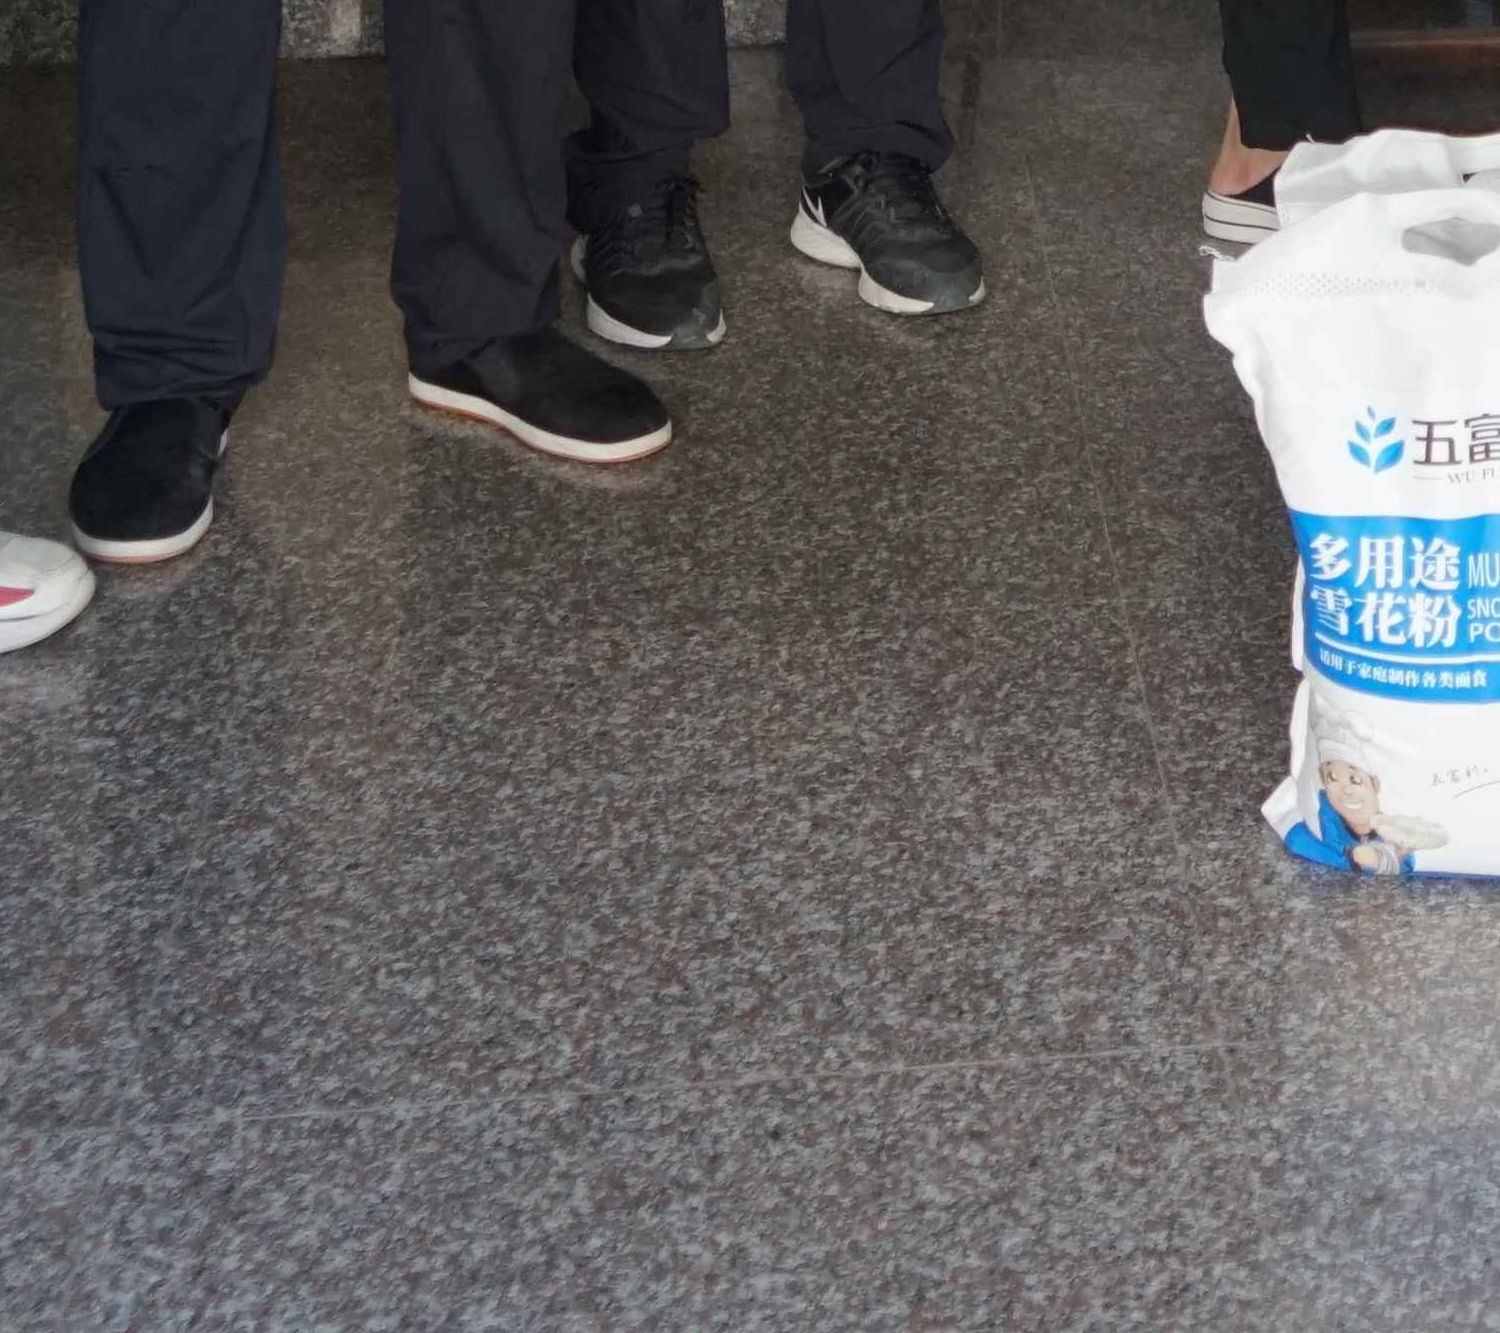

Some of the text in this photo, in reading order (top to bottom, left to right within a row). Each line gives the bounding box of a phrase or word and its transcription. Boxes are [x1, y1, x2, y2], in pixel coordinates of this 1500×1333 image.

[1308, 532, 1462, 591] 多用途
[1309, 587, 1463, 649] 雪花粉
[1319, 647, 1488, 688] 适用于家庭制作各类面食
